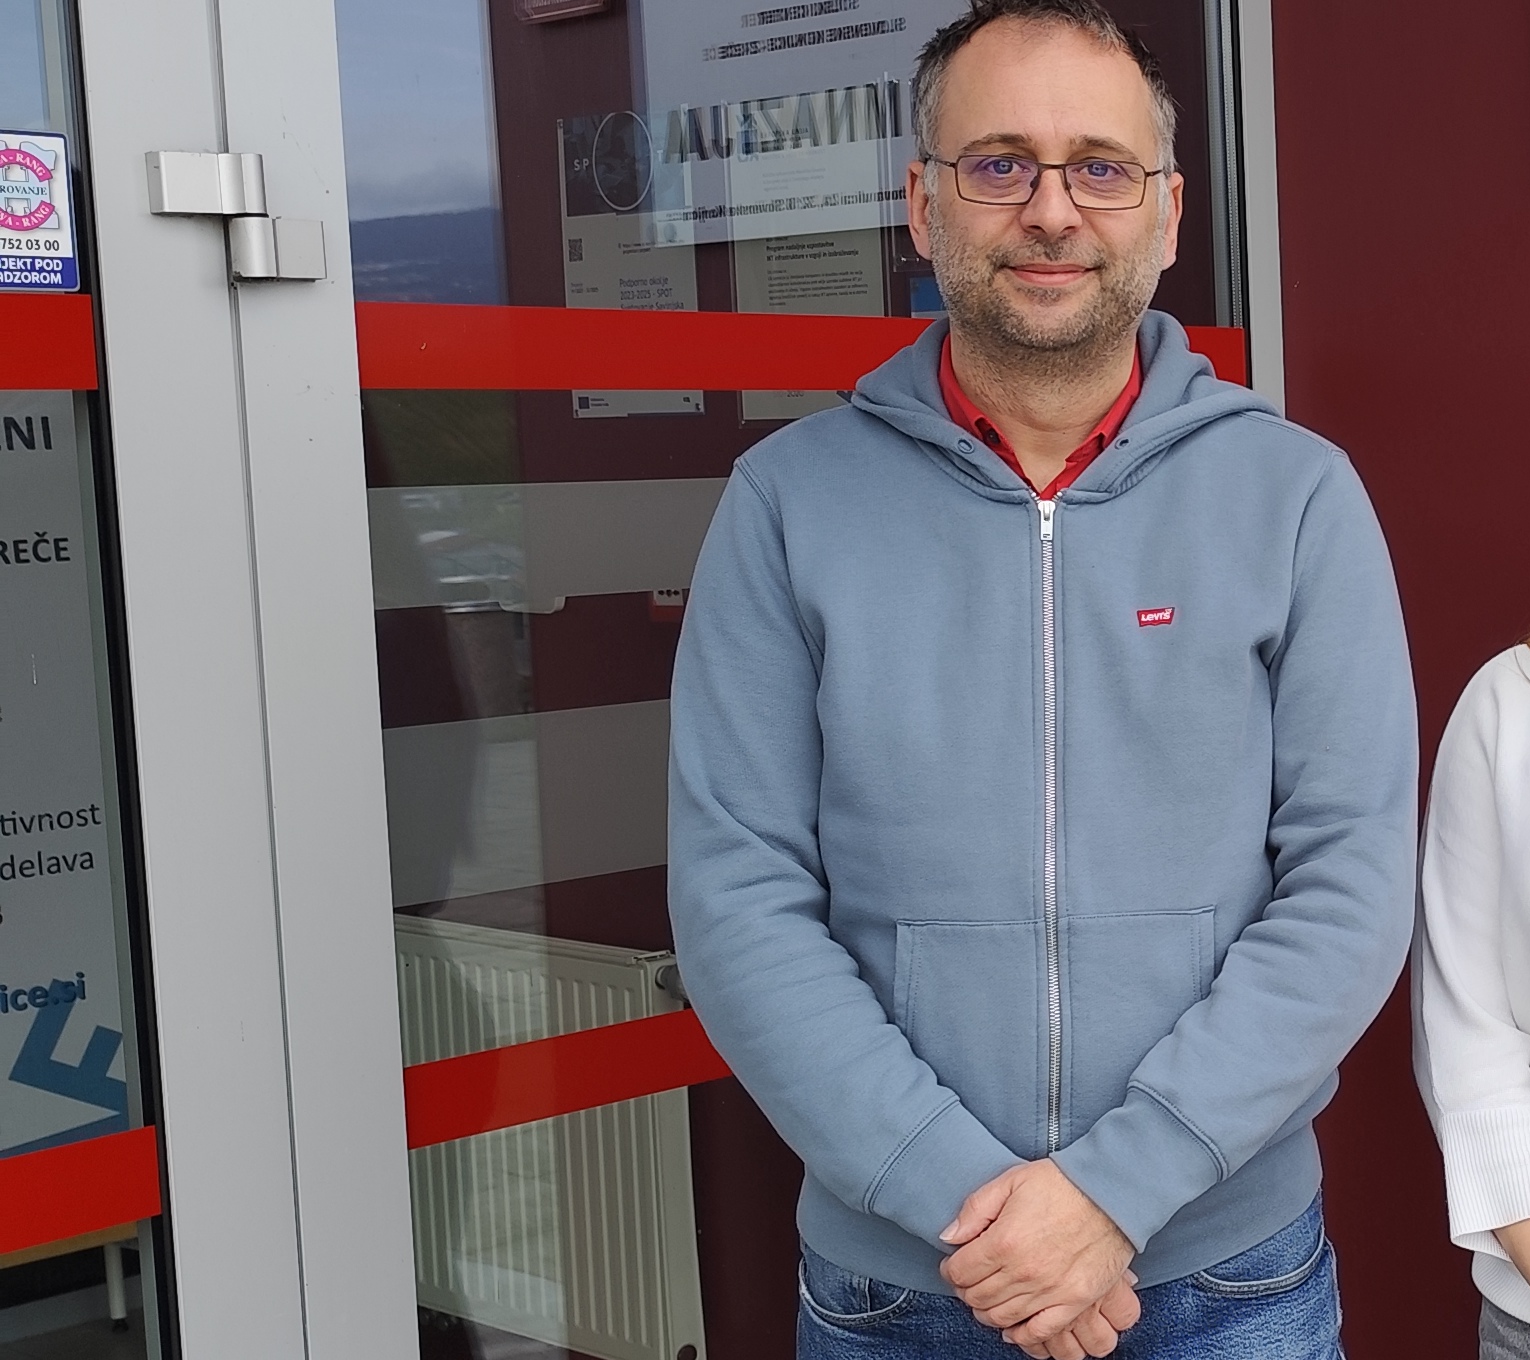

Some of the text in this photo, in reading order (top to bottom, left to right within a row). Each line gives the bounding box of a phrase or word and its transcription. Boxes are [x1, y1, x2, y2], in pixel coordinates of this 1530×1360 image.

[0, 238, 59, 251] 752 03 00
[0, 258, 62, 271] JEKT POD
[0, 416, 53, 451] NI
[0, 803, 102, 837] tivnost
[0, 849, 95, 881] delava
